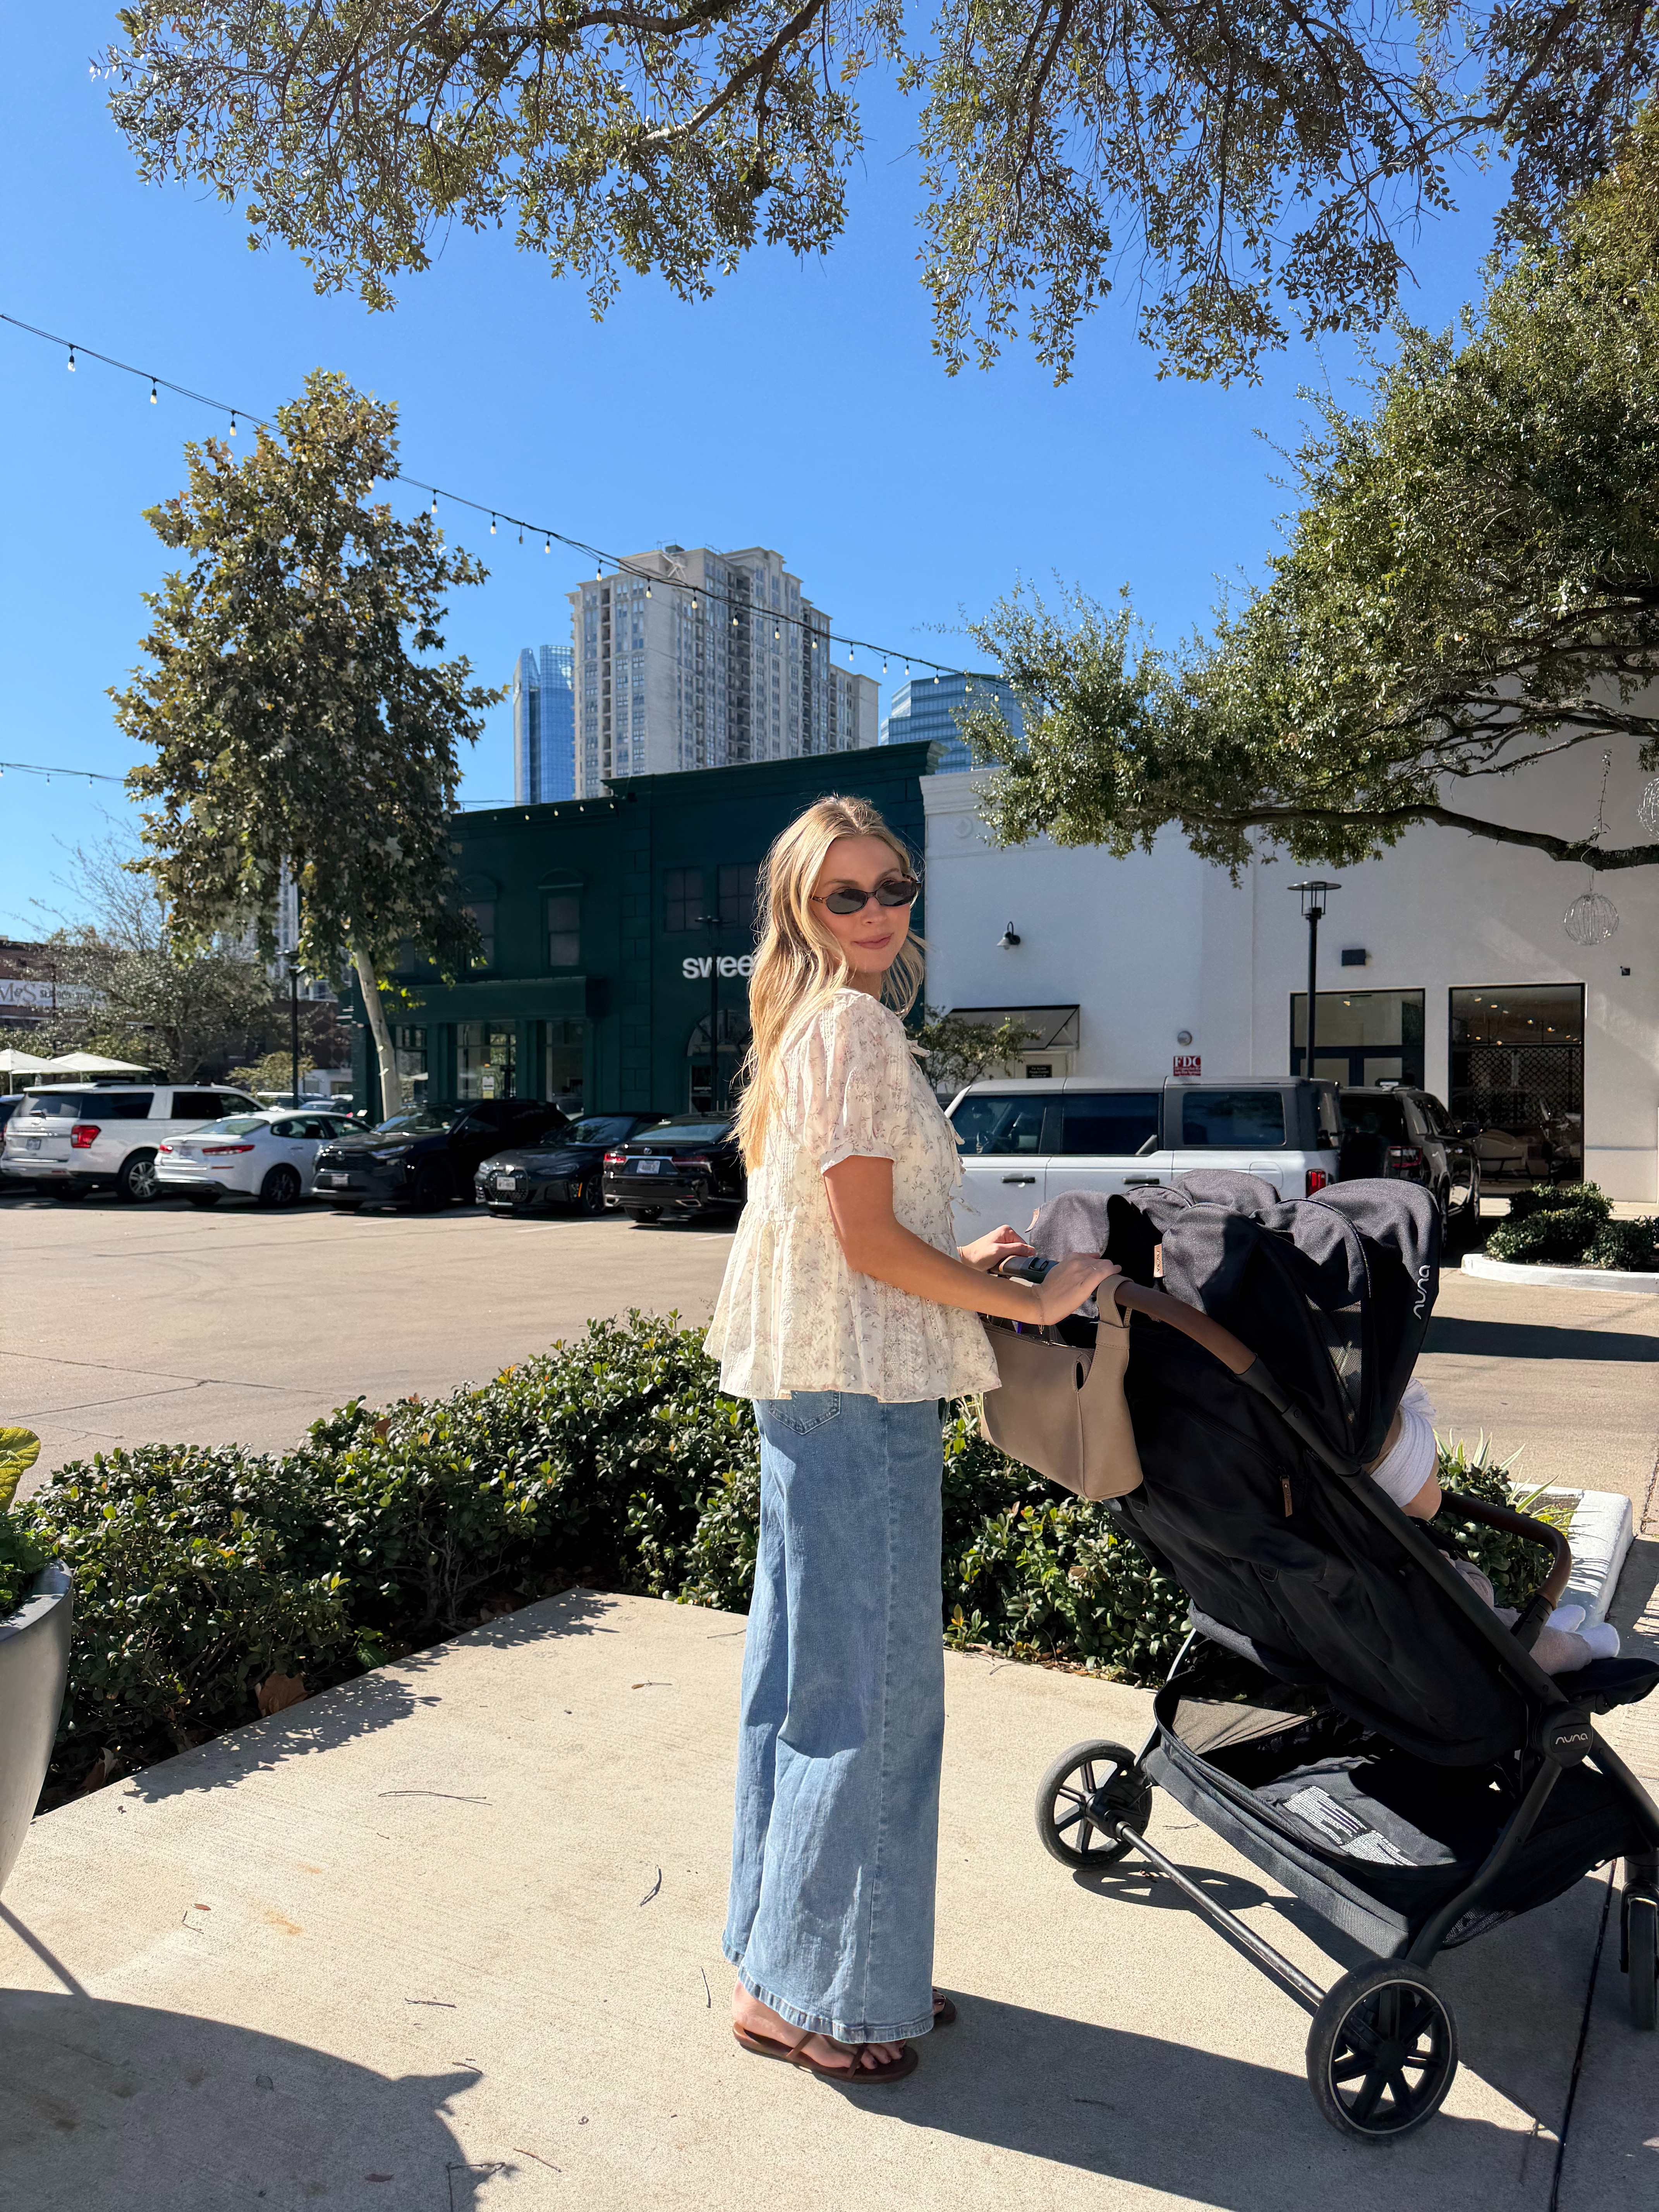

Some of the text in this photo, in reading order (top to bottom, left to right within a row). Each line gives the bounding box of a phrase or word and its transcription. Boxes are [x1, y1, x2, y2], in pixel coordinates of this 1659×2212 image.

[1175, 1056, 1200, 1067] FDC
[1413, 1265, 1430, 1320] nuna
[1555, 1733, 1588, 1744] nuna
